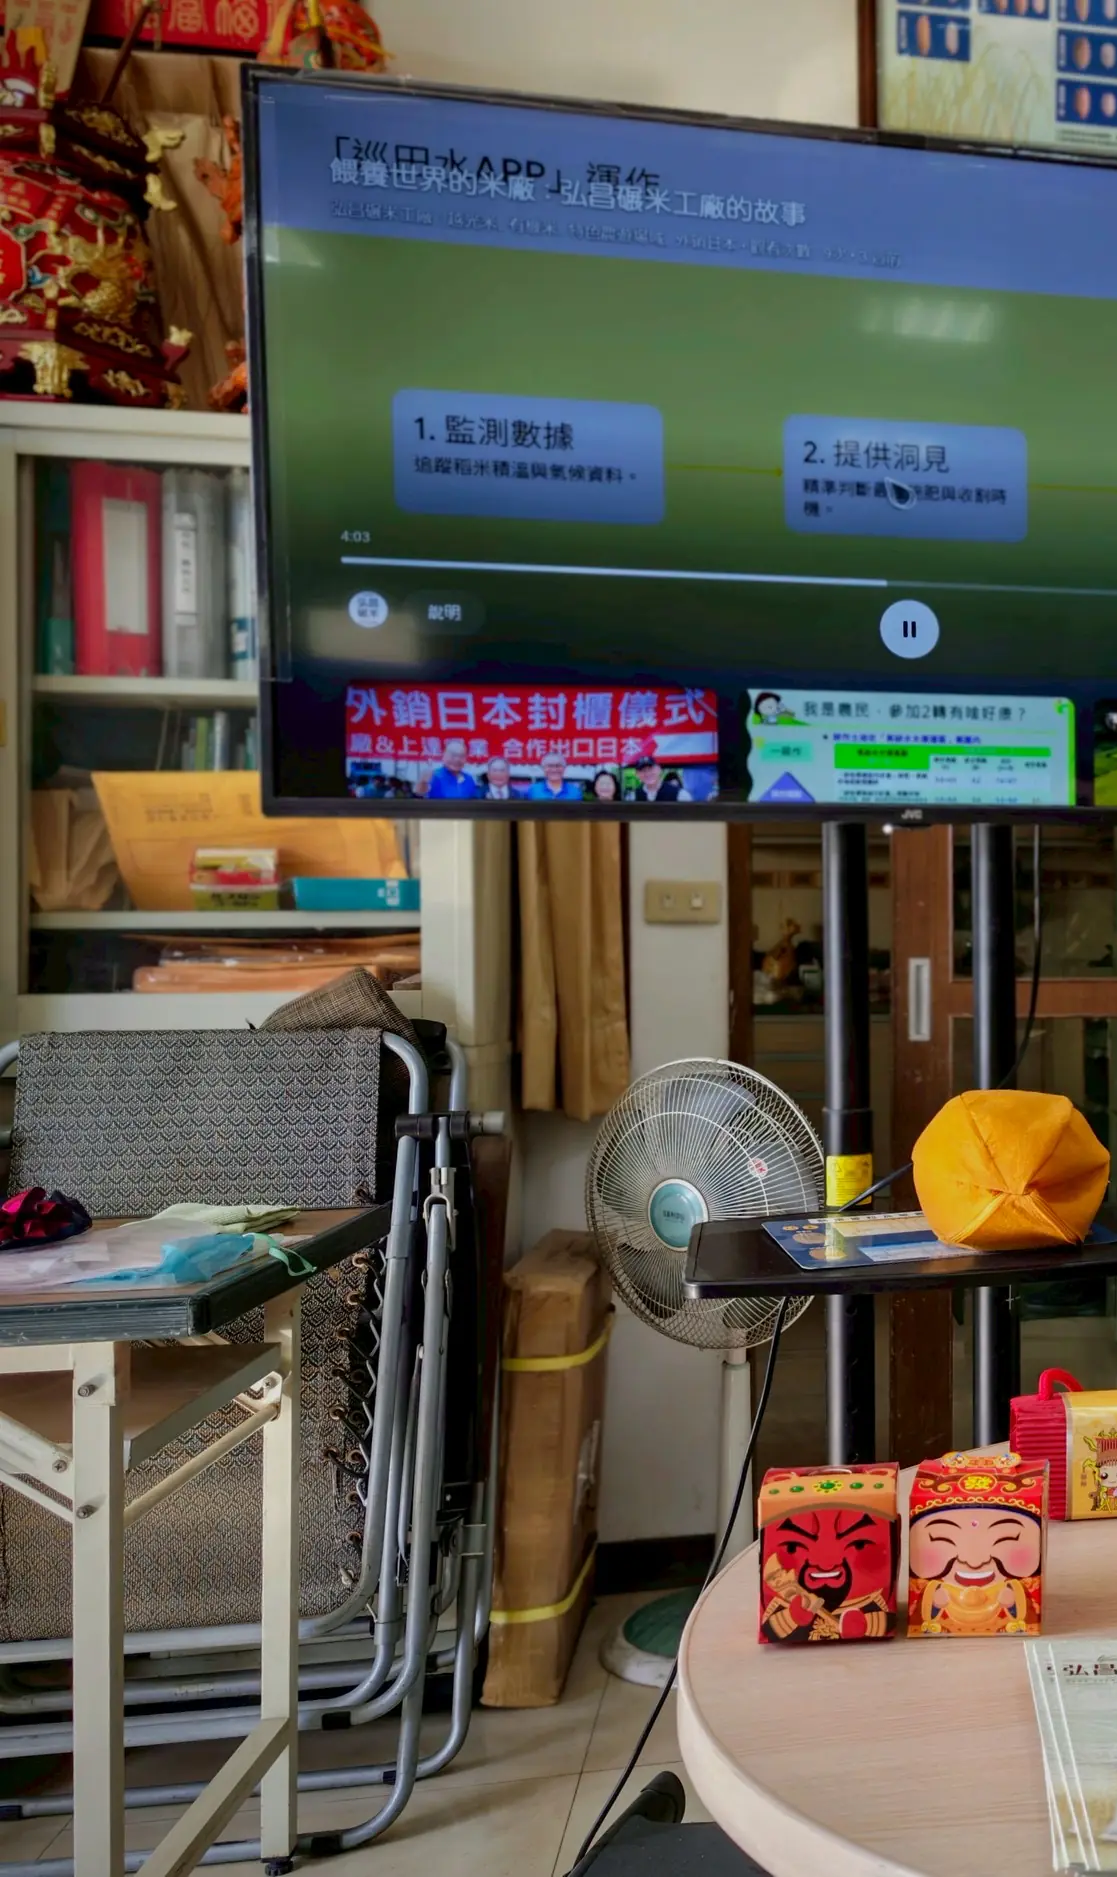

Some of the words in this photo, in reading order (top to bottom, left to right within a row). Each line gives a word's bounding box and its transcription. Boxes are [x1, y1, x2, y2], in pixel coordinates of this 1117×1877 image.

[414, 416, 436, 441] 1.
[445, 414, 575, 451] 監測數據
[803, 440, 825, 464] 2.
[833, 439, 951, 474] 提供洞見
[340, 530, 371, 543] 4:03
[346, 686, 706, 731] 外銷日本封櫃儀式
[901, 809, 922, 820] JVC
